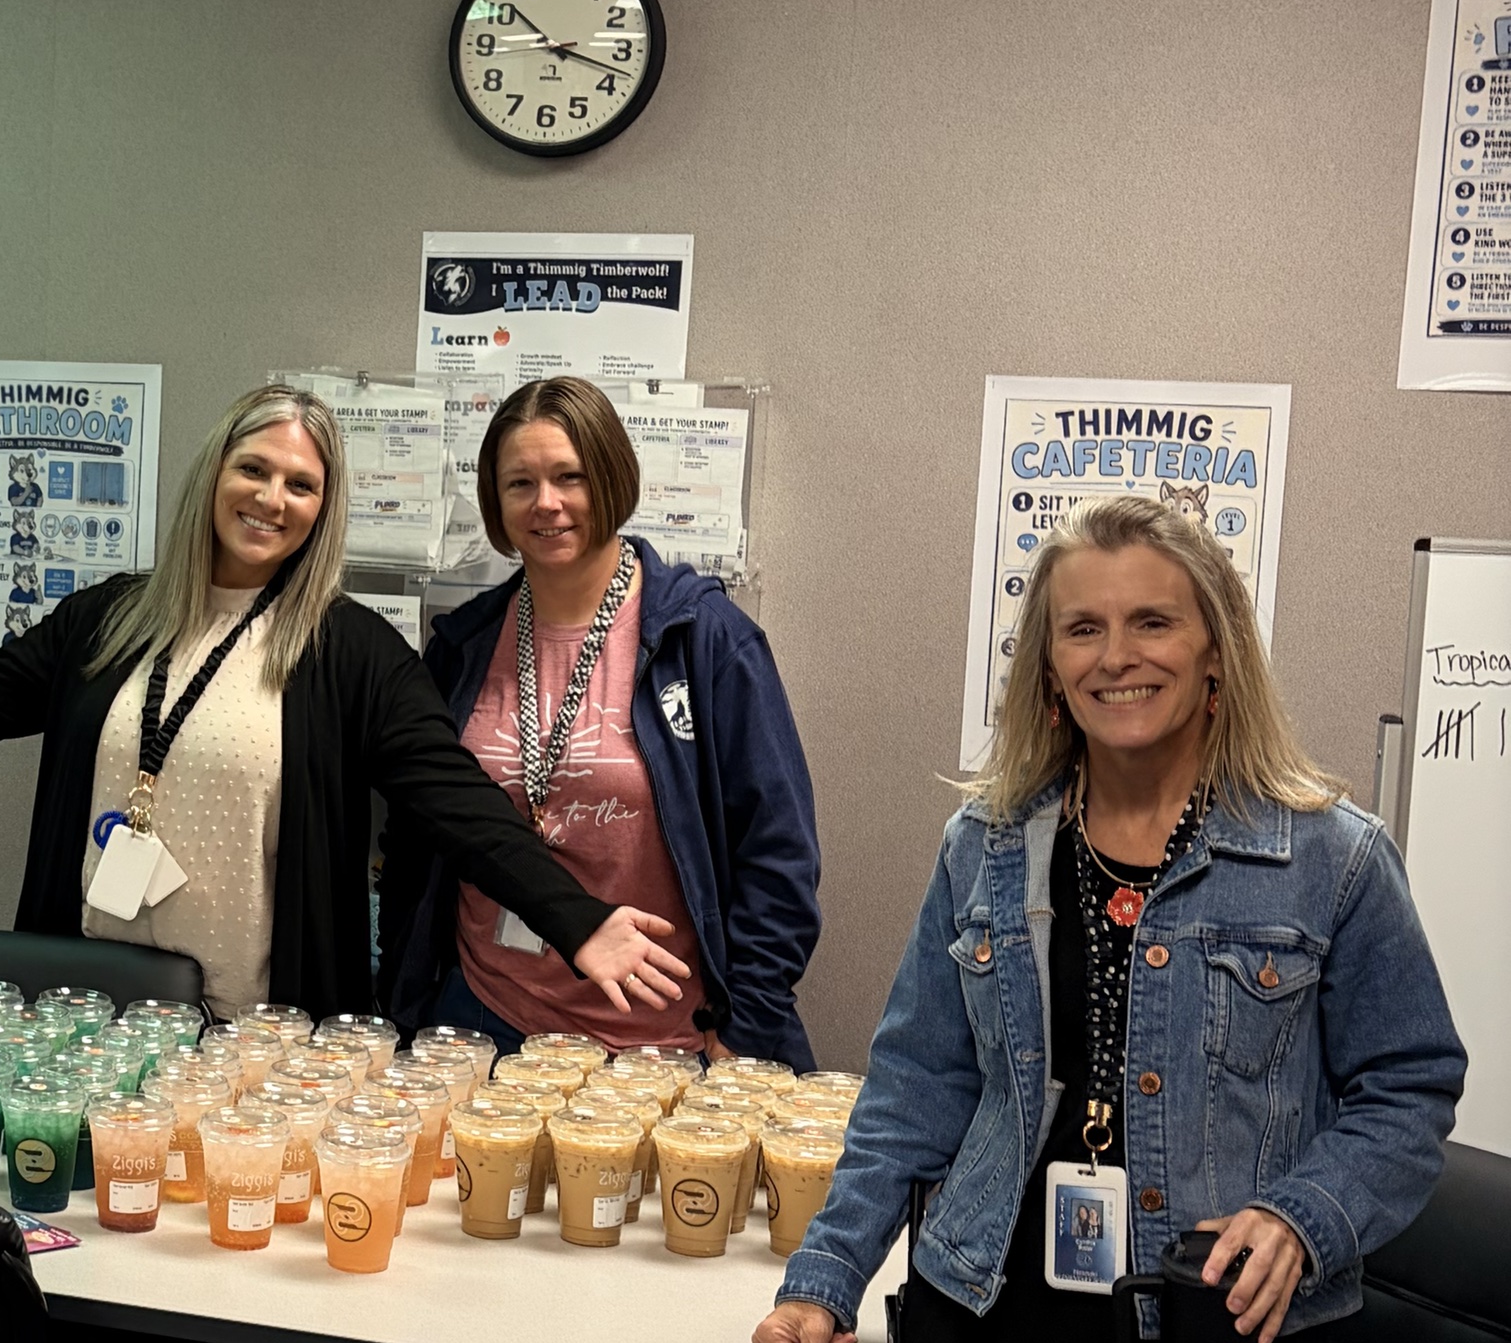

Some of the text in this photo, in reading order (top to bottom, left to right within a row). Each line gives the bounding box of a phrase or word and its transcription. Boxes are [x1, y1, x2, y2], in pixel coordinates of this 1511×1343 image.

[487, 2, 516, 26] 10
[606, 6, 626, 29] 2
[475, 33, 495, 57] 9
[611, 38, 633, 62] 3
[483, 68, 503, 92] 8
[595, 73, 616, 96] 4
[1472, 78, 1479, 90] 1
[1491, 75, 1511, 84] KEE
[1489, 87, 1511, 95] HAN
[505, 94, 524, 116] 7
[568, 96, 588, 119] 5
[536, 105, 557, 128] 6
[1465, 132, 1474, 144] 2
[1459, 184, 1469, 197] 3
[1456, 230, 1465, 242] 4
[1475, 228, 1493, 237] USE
[492, 262, 669, 277] I'm a Thimmig Timberwolf!
[491, 280, 667, 313] I LEAD the Pack!
[430, 326, 488, 346] Learn
[336, 408, 428, 418] AREA & GET YOUR STAMP!
[627, 417, 647, 426] AREA
[650, 417, 656, 426] &
[659, 418, 673, 427] GET
[676, 419, 697, 428] YOUR
[699, 420, 729, 431] STAMP!
[1055, 408, 1213, 442] THIMMIG
[1011, 439, 1257, 488] CAFETERIA
[1018, 495, 1027, 509] 1
[1038, 495, 1063, 511] SIT
[1227, 519, 1234, 531] 1
[1010, 579, 1020, 593] 2
[1425, 644, 1511, 681] Tropica
[112, 1155, 156, 1176] Ziggi's
[231, 1172, 274, 1192] Ziggi's
